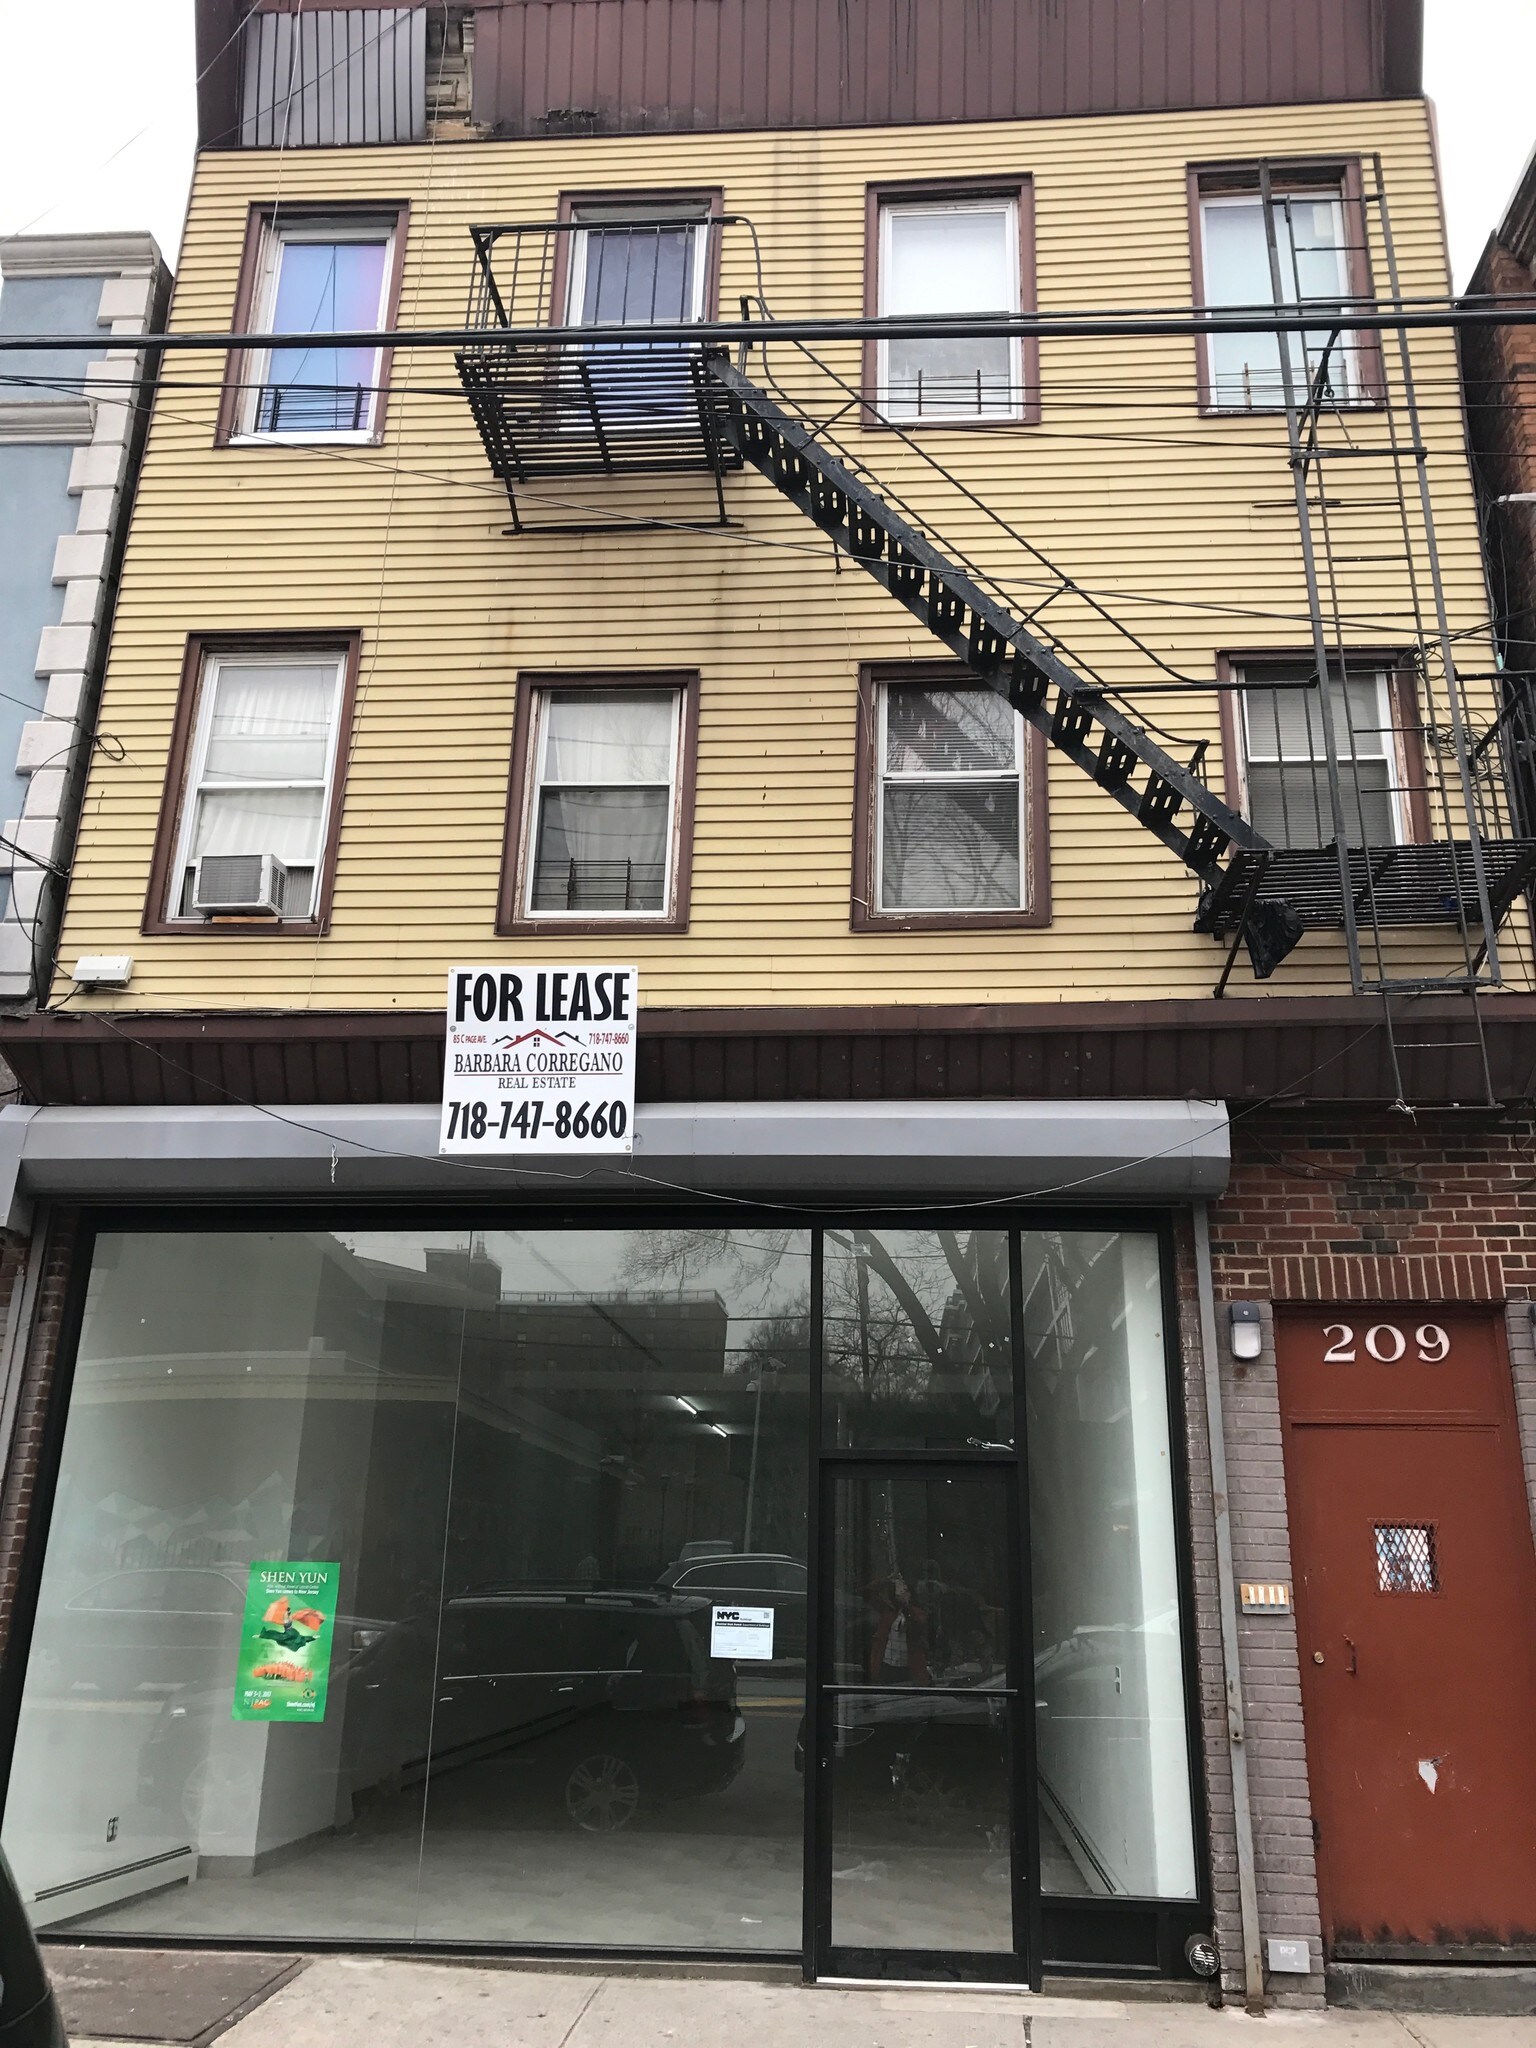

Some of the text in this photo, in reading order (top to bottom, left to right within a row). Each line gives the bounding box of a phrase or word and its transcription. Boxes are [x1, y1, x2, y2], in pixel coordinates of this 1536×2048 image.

[455, 972, 630, 1022] FOR LEASE
[588, 1033, 630, 1045] 718-747-8660
[454, 1052, 623, 1073] BARBARA CORREGANO
[498, 1076, 577, 1089] REAL ESTATE
[446, 1100, 627, 1140] 718-747-8660
[1322, 1324, 1451, 1363] 209
[260, 1571, 328, 1584] SHEN YUN
[717, 1611, 740, 1620] NYC
